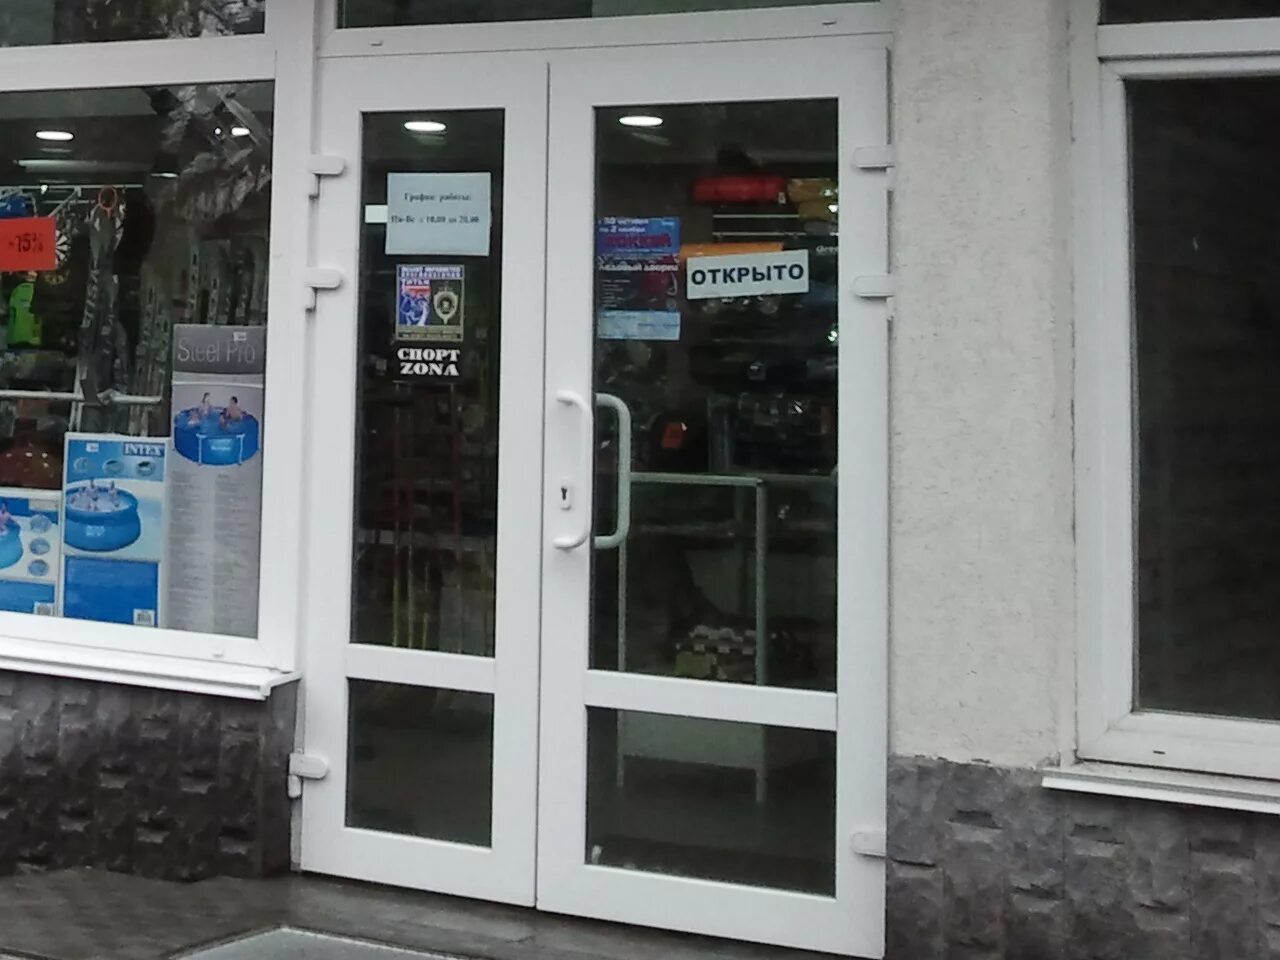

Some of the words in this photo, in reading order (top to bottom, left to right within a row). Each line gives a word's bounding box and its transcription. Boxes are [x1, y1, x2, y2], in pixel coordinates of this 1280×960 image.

[690, 264, 804, 286] ОТКРЫТО
[178, 337, 220, 362] Steel
[397, 348, 460, 361] СПОРТ
[400, 362, 459, 376] ZONA
[124, 443, 162, 457] INTEX
